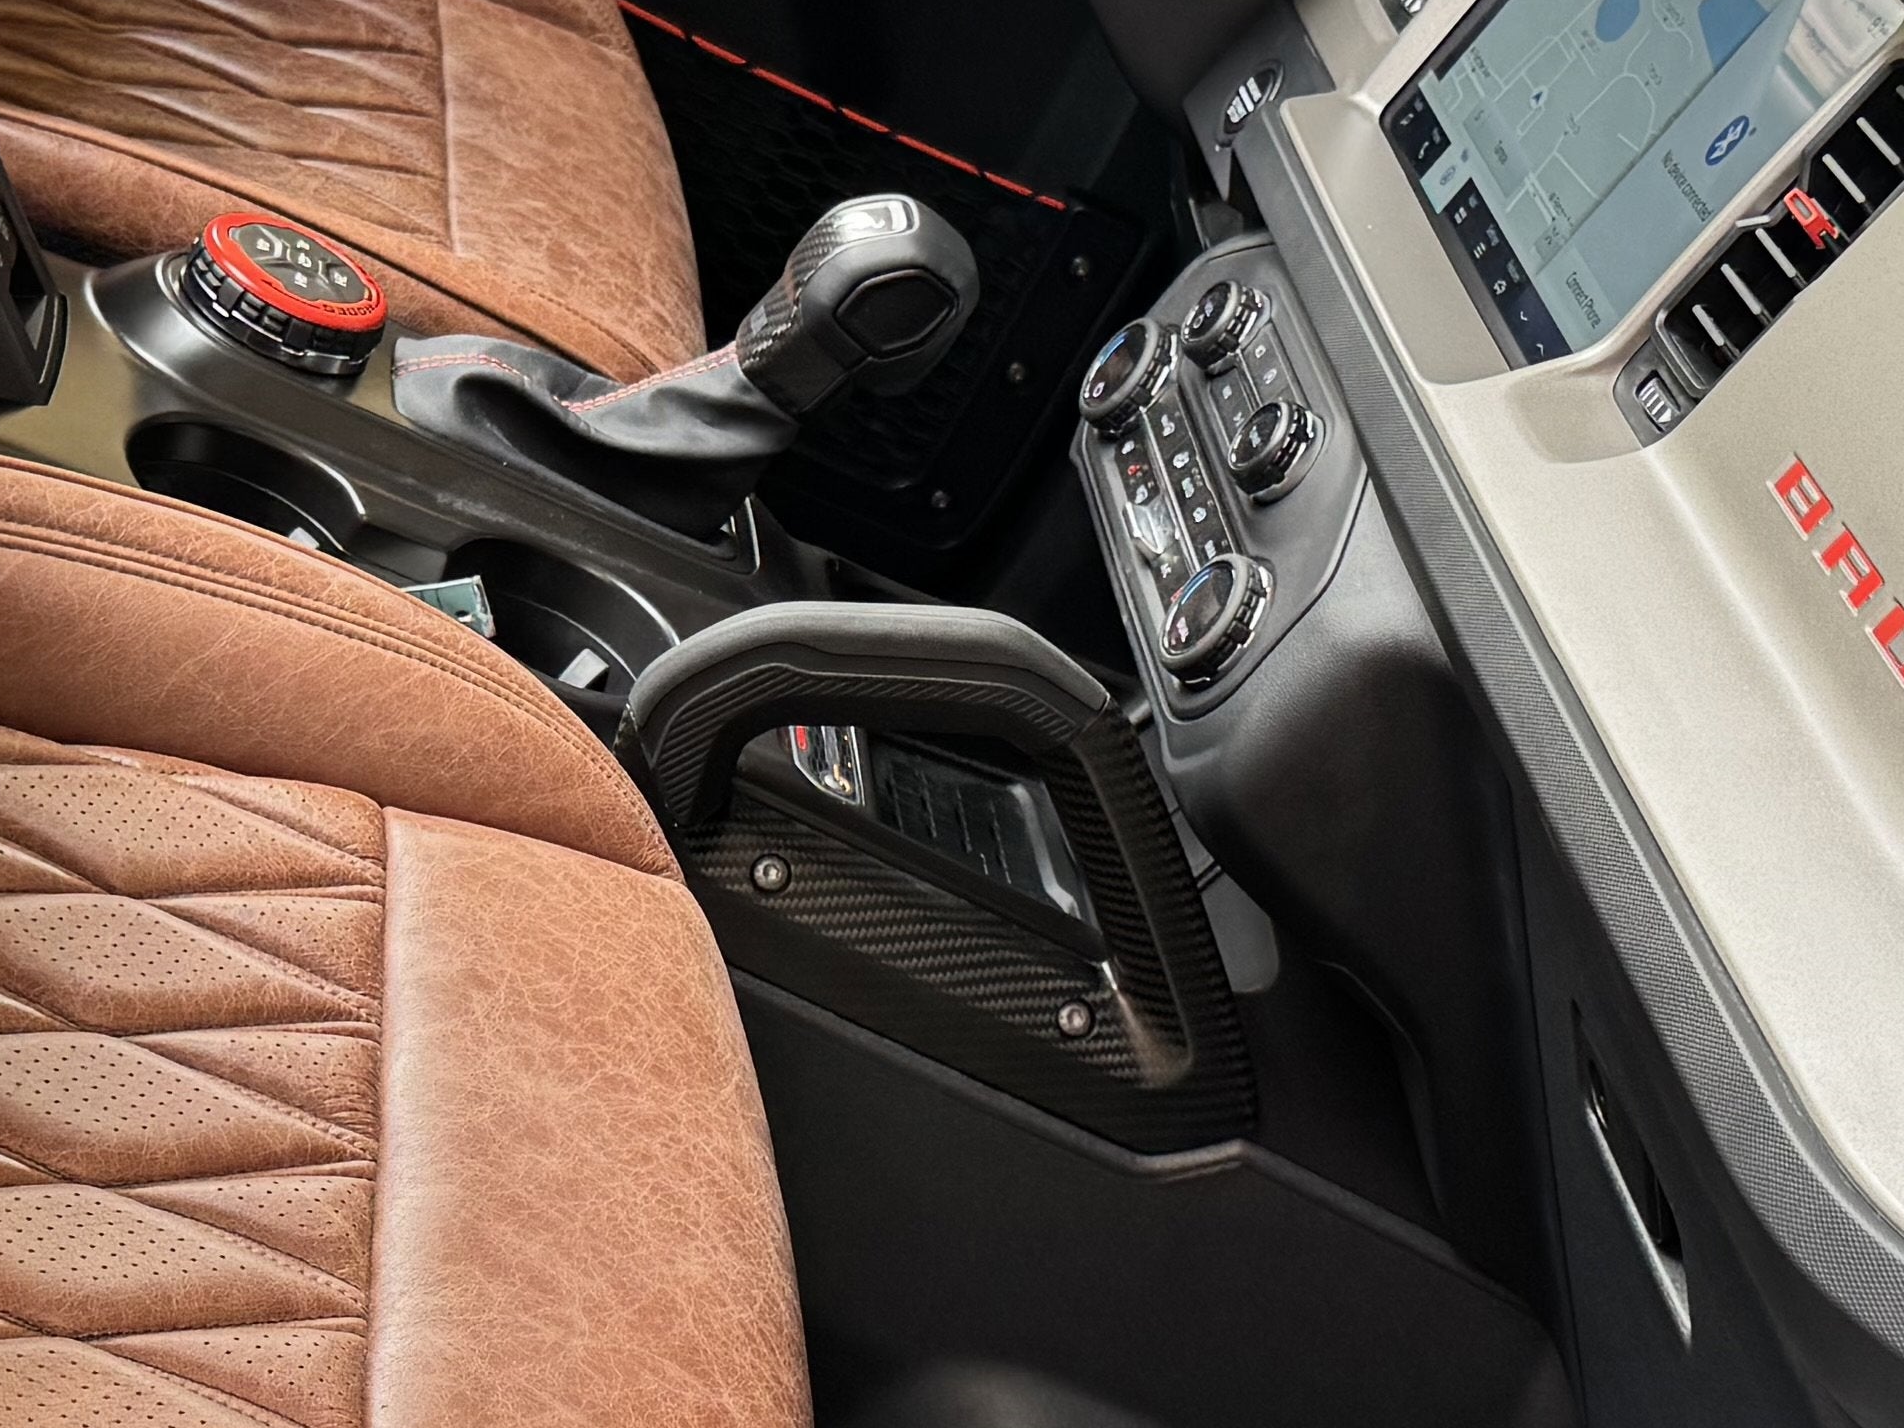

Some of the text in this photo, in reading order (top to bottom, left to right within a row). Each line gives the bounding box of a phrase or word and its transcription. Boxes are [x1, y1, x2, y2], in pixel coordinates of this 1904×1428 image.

[1667, 162, 1688, 190] device
[1680, 183, 1715, 223] connected
[1566, 271, 1588, 308] Connect
